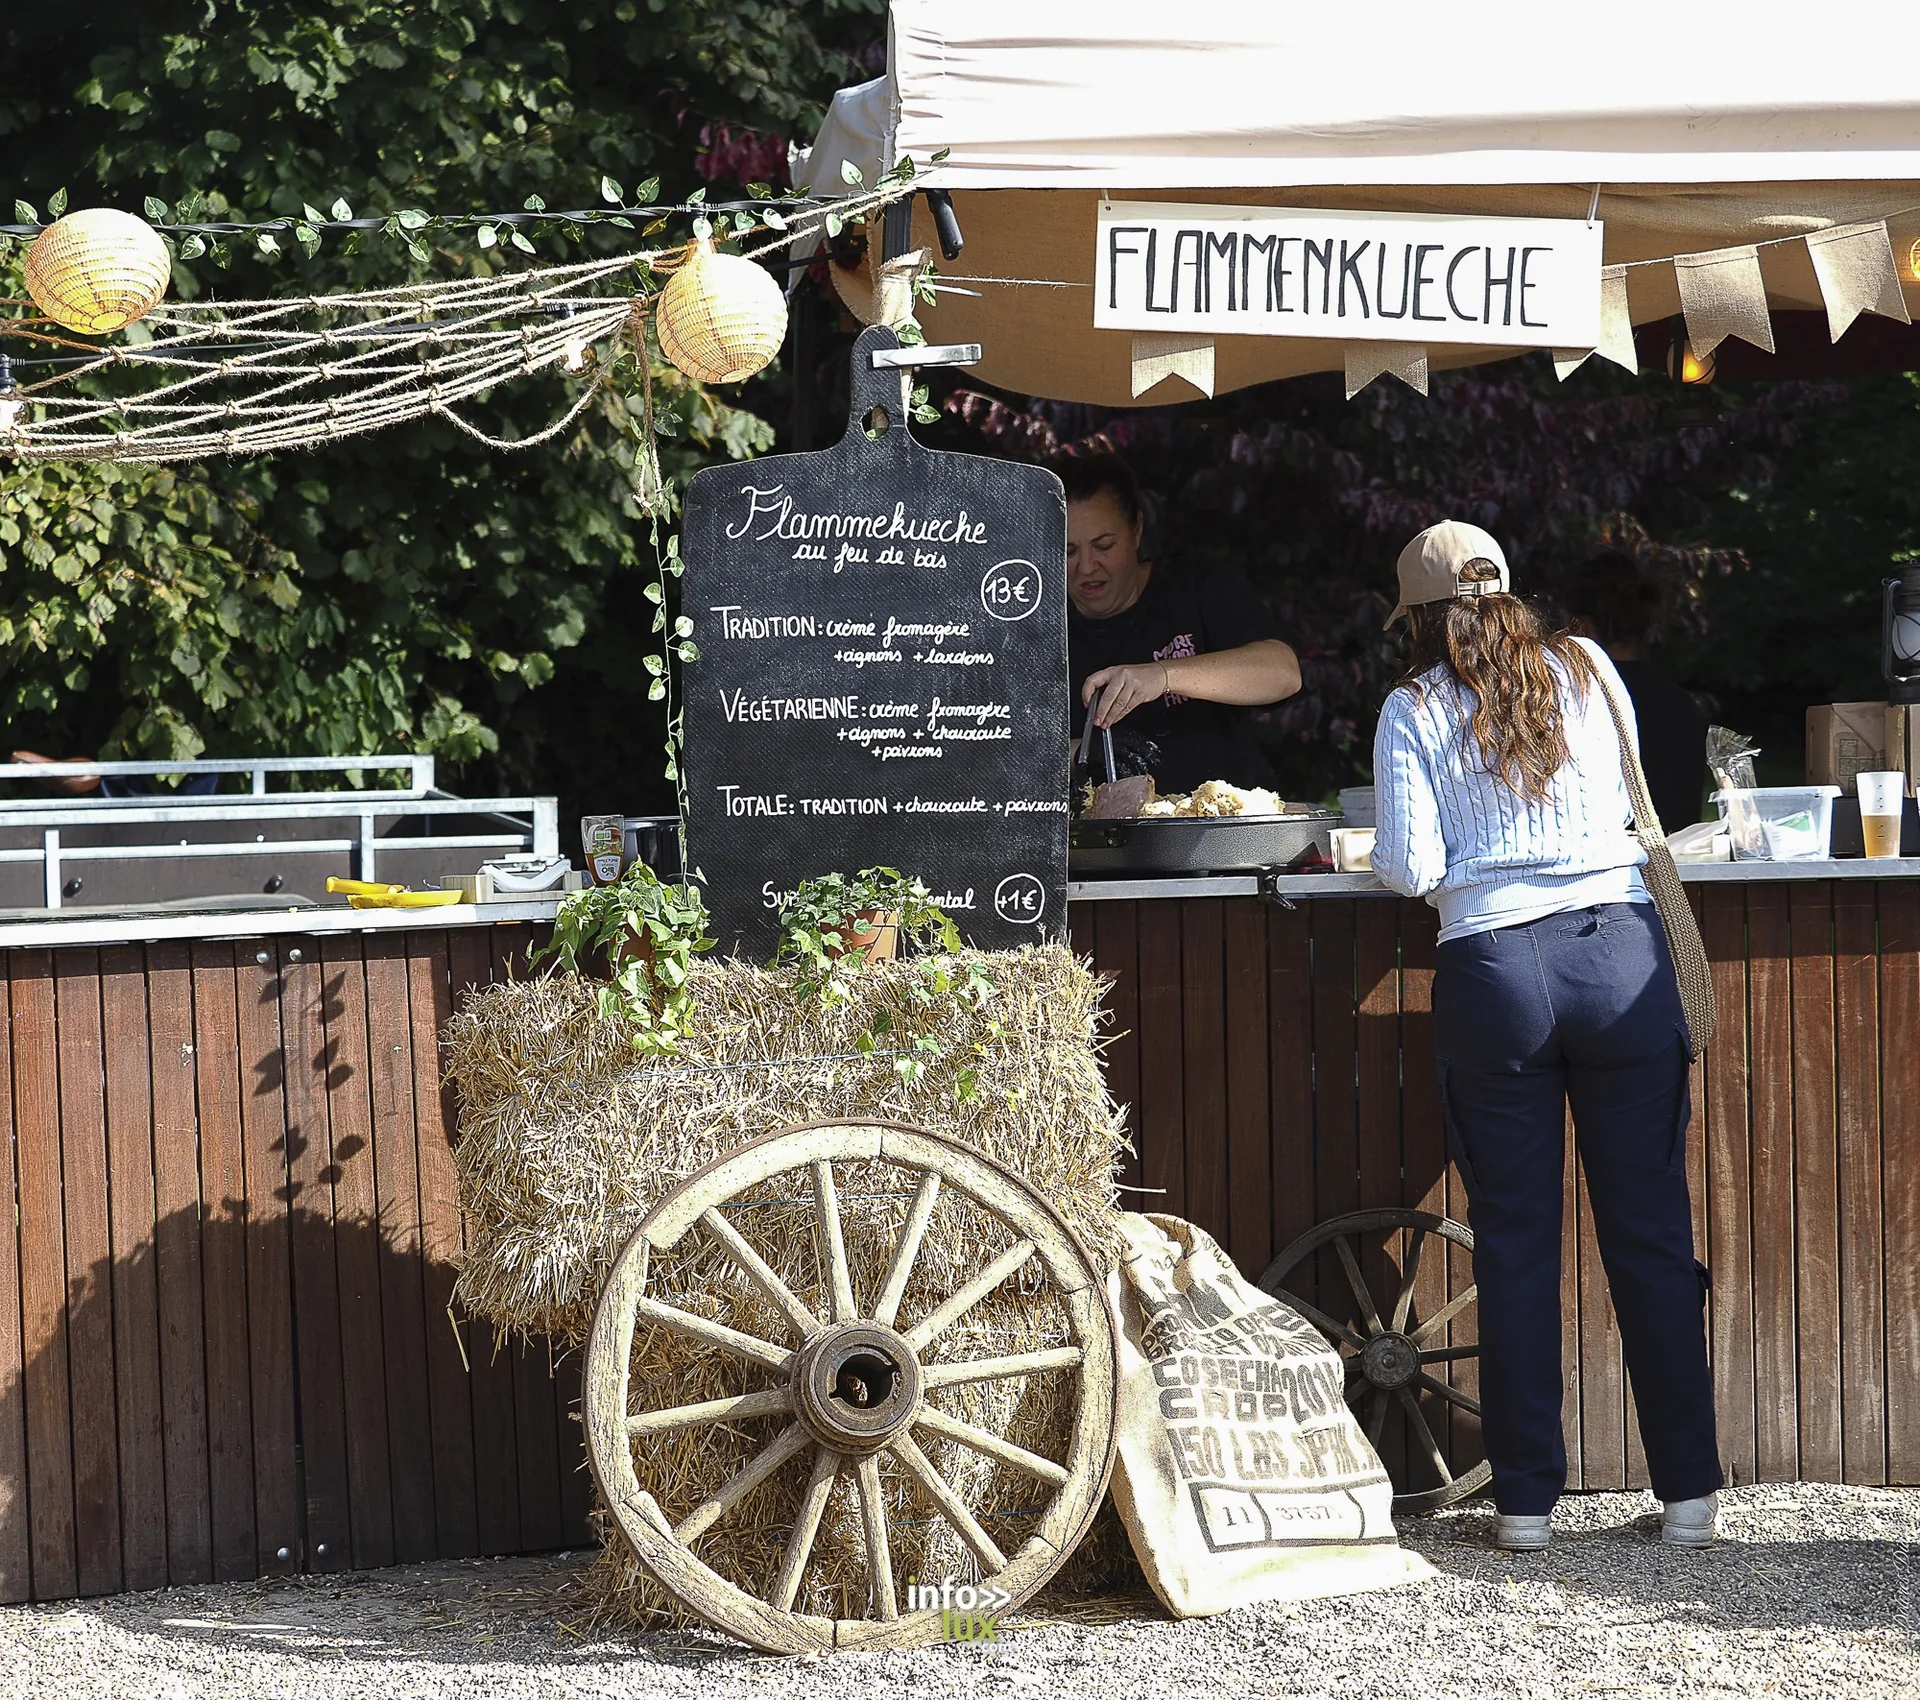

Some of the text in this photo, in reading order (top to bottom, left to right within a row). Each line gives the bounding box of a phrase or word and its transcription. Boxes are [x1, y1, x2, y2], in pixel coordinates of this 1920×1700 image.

[1110, 228, 1553, 327] FLAMMENKUECHE
[726, 484, 987, 546] Flammekueche
[792, 544, 827, 559] au
[834, 542, 869, 573] feu
[876, 546, 905, 564] de
[985, 577, 1030, 605] 13€
[800, 797, 887, 814] TRADITION
[1152, 1354, 1283, 1394] COSECHA
[1158, 1390, 1287, 1423] CROP
